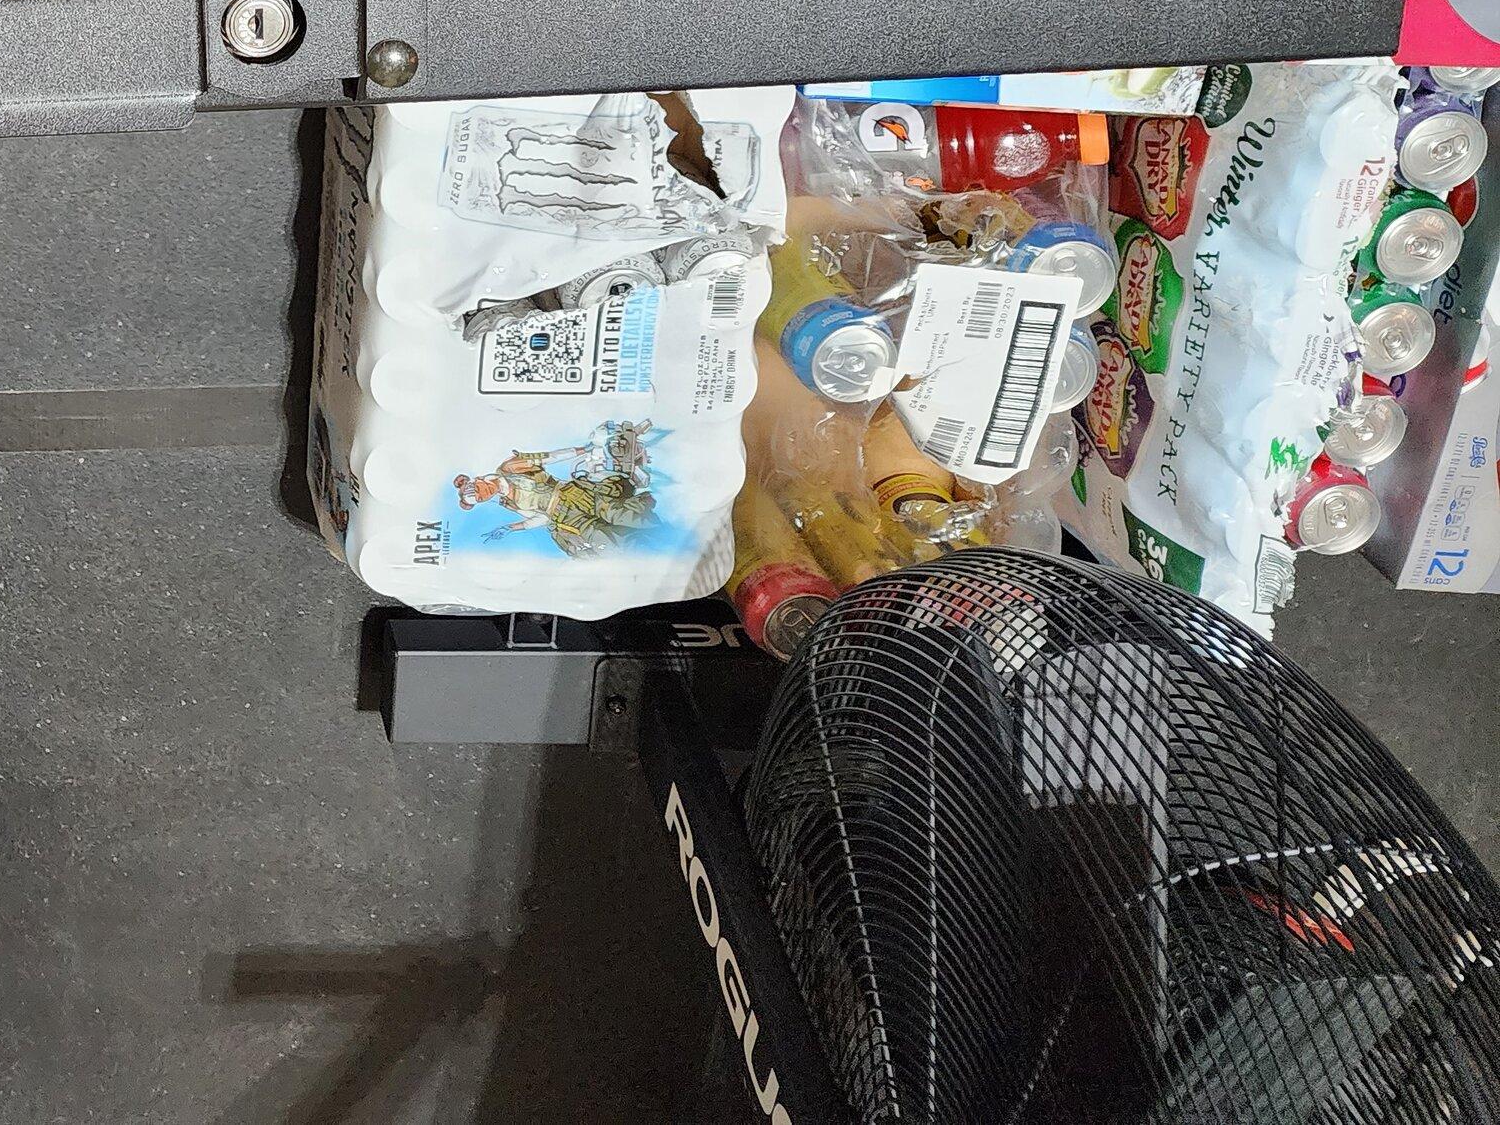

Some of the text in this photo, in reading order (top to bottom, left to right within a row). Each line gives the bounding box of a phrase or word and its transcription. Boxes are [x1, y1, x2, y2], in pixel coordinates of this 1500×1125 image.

[1216, 65, 1241, 119] Limited
[450, 117, 472, 205] ZERO SUGAR
[1145, 119, 1176, 224] CANADA DRY
[1360, 157, 1385, 176] 12
[1352, 178, 1366, 212] Ginger
[677, 240, 737, 280] ZERO SUG
[1130, 235, 1154, 349] CANADA
[1157, 117, 1276, 506] Winter VARIETY PACK
[1434, 263, 1462, 325] diet
[600, 300, 624, 393] SCAN TO ENTE
[621, 308, 643, 359] DETAILS
[1318, 336, 1333, 370] Ginger
[618, 363, 637, 393] FULL
[723, 349, 737, 403] ENERGY DRINK
[1311, 371, 1322, 386] Ale
[413, 521, 442, 566] APEX
[1147, 537, 1169, 583] 36
[1428, 548, 1470, 577] 12
[1424, 577, 1450, 586] cans
